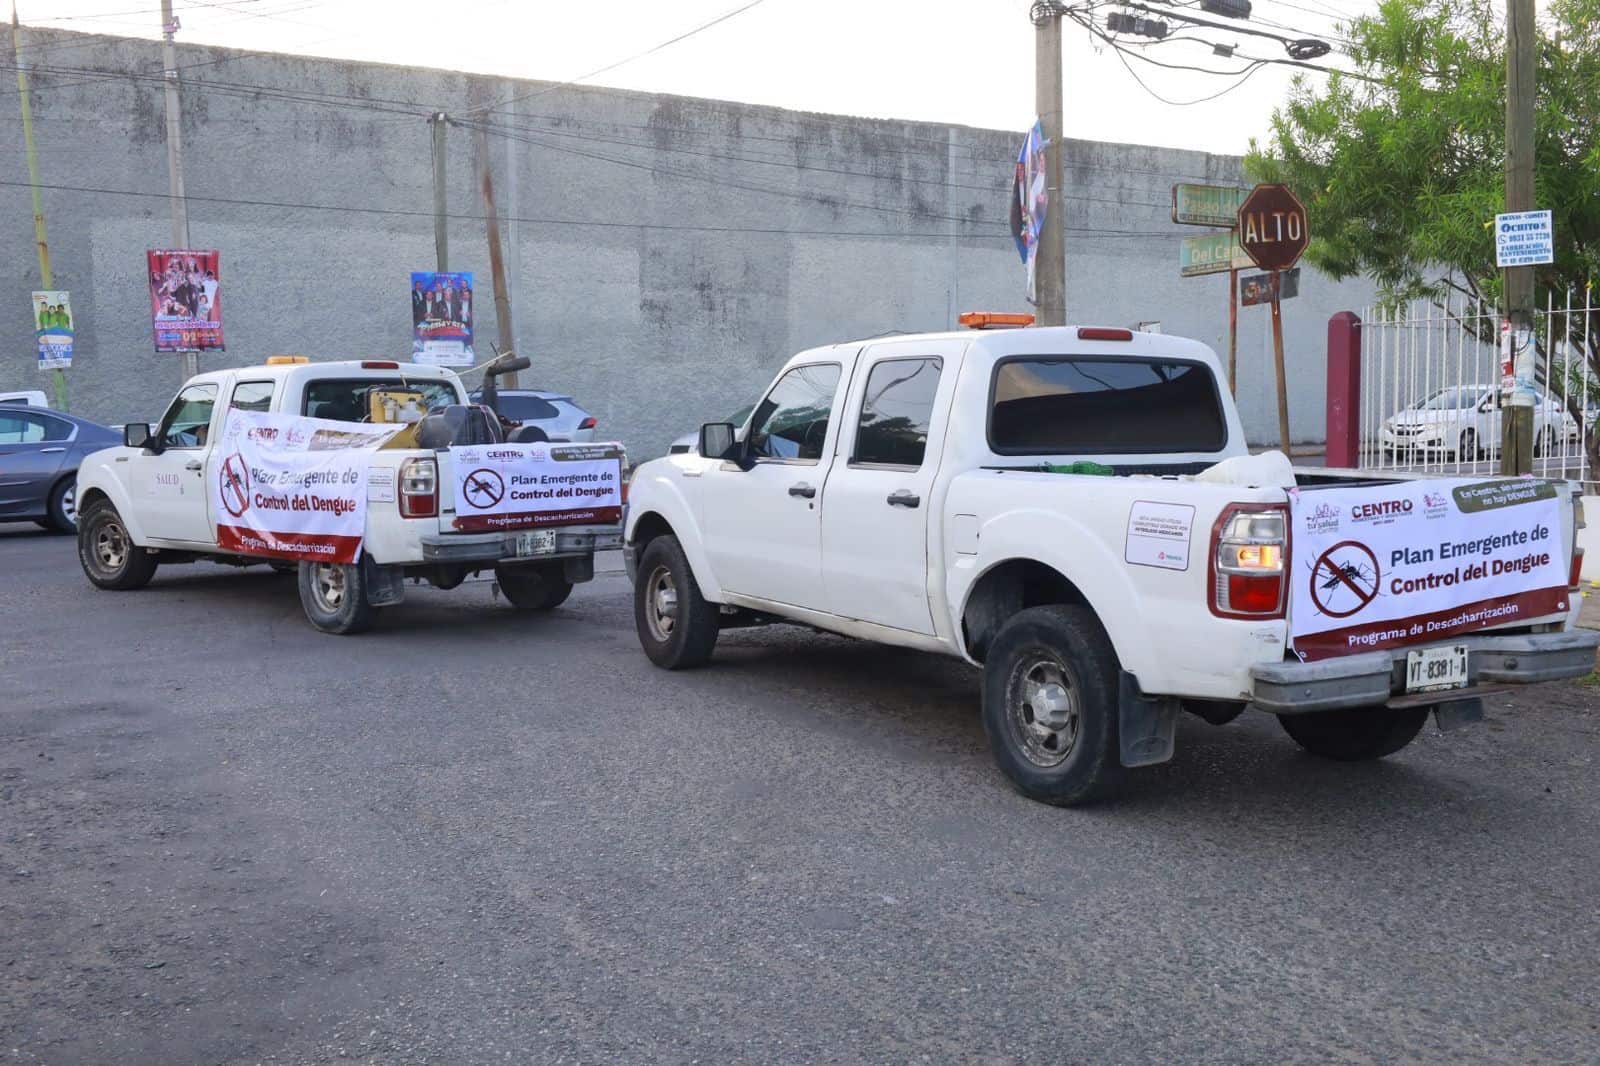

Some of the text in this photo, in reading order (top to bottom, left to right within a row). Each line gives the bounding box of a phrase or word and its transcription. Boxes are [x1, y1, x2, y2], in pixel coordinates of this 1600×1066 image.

[1246, 212, 1300, 243] ALTO
[1192, 249, 1212, 262] Del
[248, 427, 279, 440] CENTRO
[487, 451, 523, 459] CENTRO
[157, 473, 179, 485] SALUD
[342, 468, 358, 484] de
[511, 472, 613, 486] Plan Emergente de
[510, 487, 614, 500] Control del Dengue
[255, 493, 356, 516] Control del Dengue
[1352, 498, 1414, 519] CENTRO
[487, 517, 522, 526] Programa
[534, 512, 594, 523] Descacharrización
[1307, 519, 1339, 530] tu salud
[1391, 524, 1549, 567] Plan Emergente de
[1390, 553, 1550, 595] Control del Dengue
[1348, 602, 1519, 646] Programa de Descacharrización
